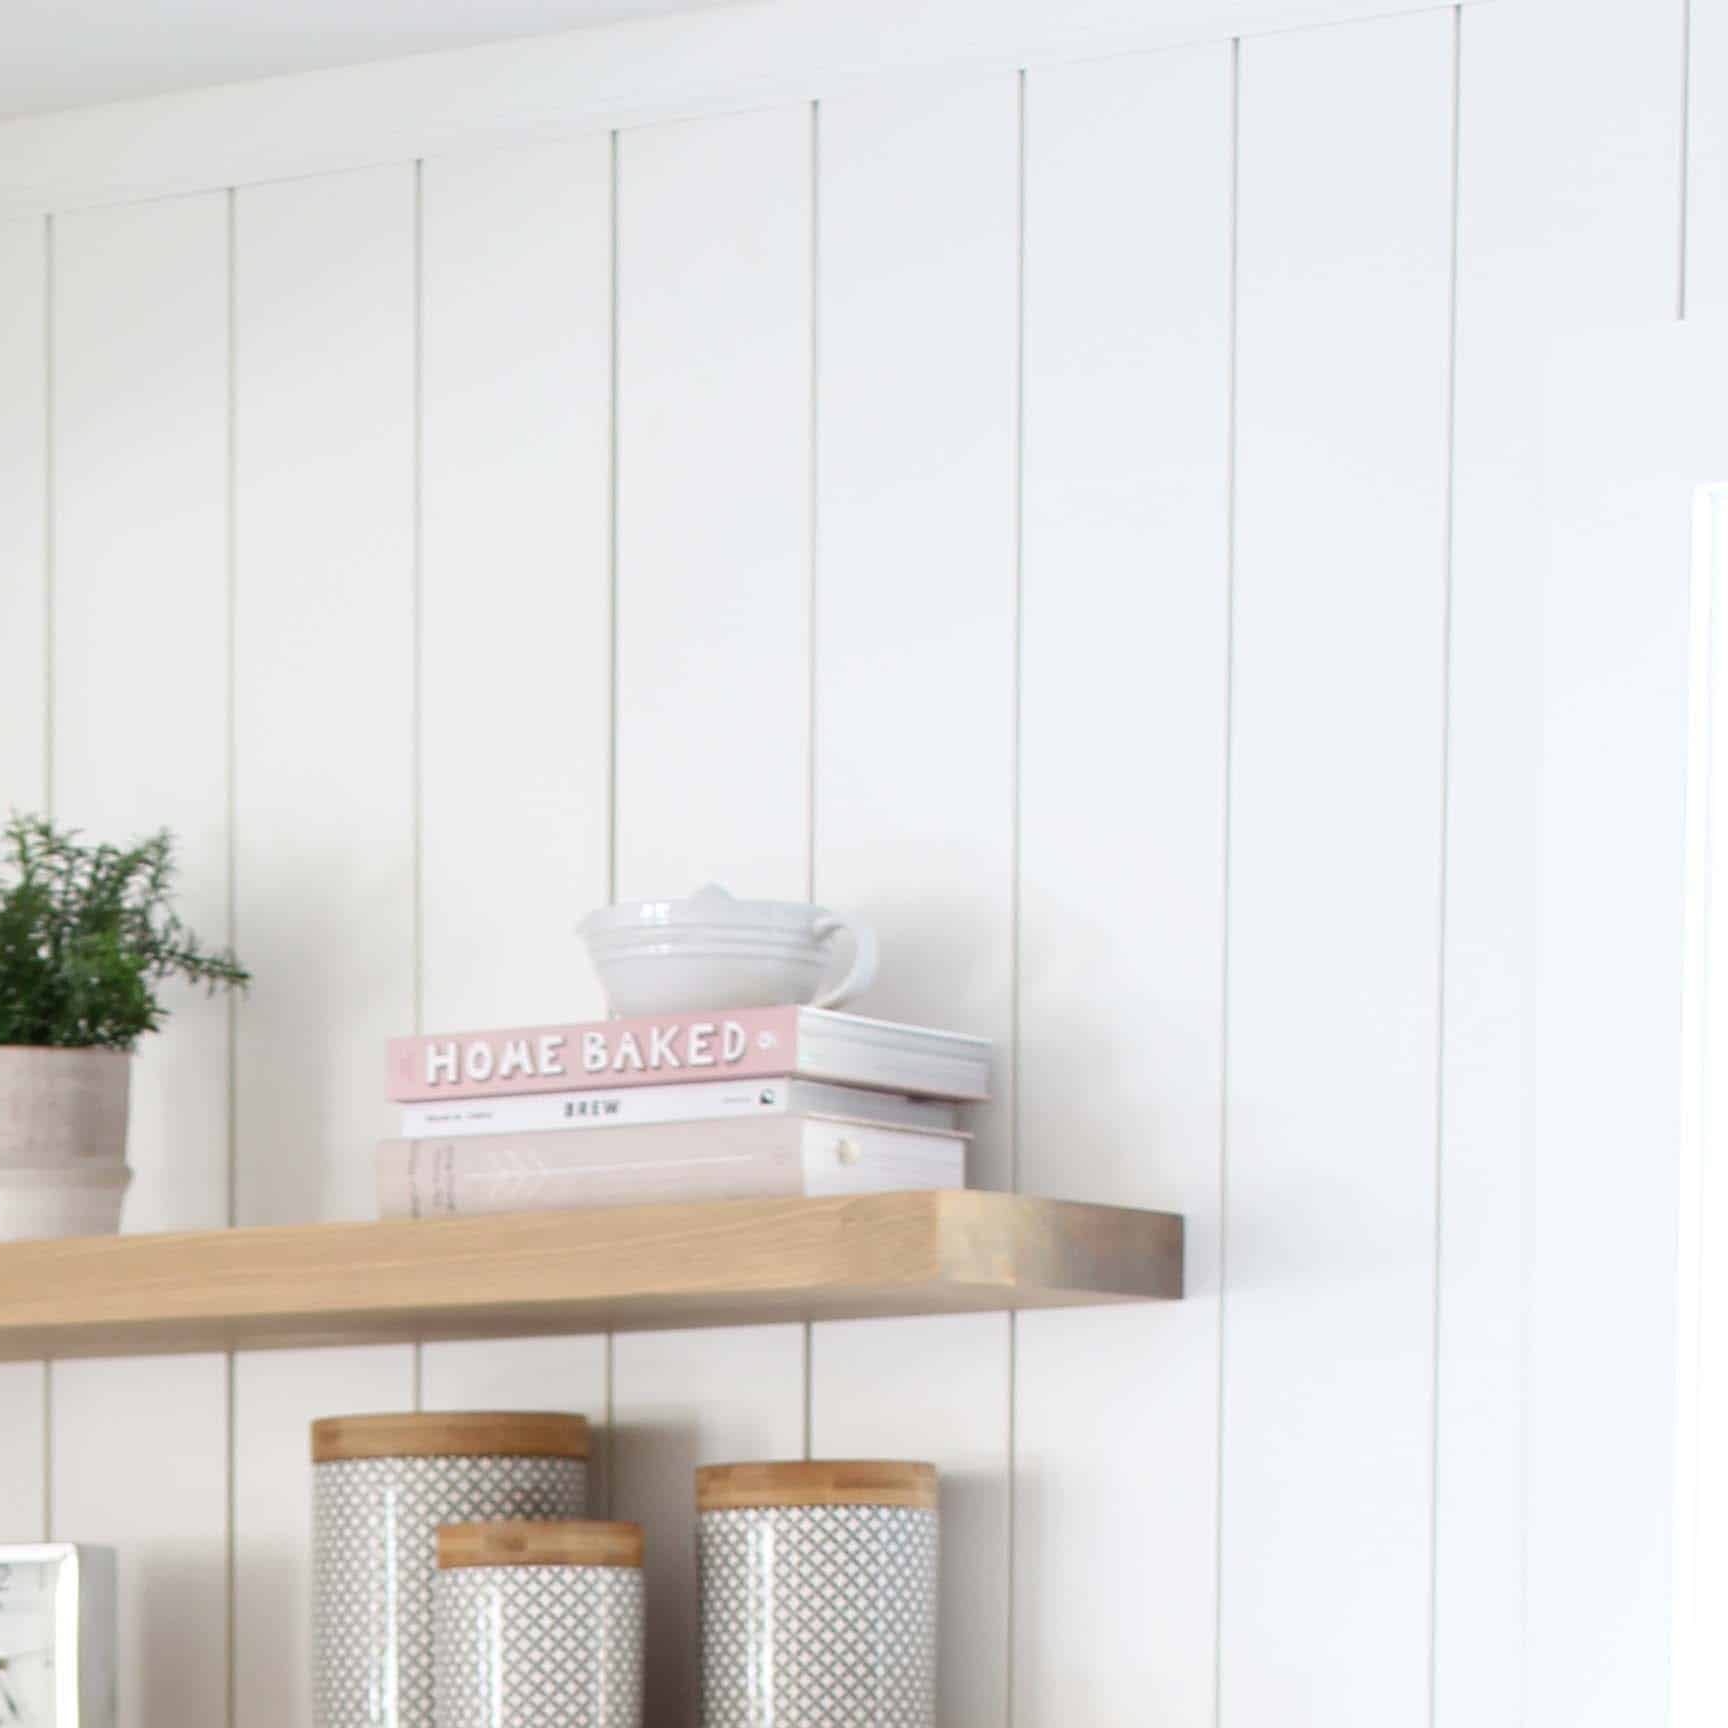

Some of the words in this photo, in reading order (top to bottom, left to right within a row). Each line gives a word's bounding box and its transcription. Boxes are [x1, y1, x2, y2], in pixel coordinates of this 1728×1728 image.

[426, 1035, 565, 1086] HOME
[581, 1021, 747, 1073] BAKED
[564, 1100, 620, 1118] BREW
